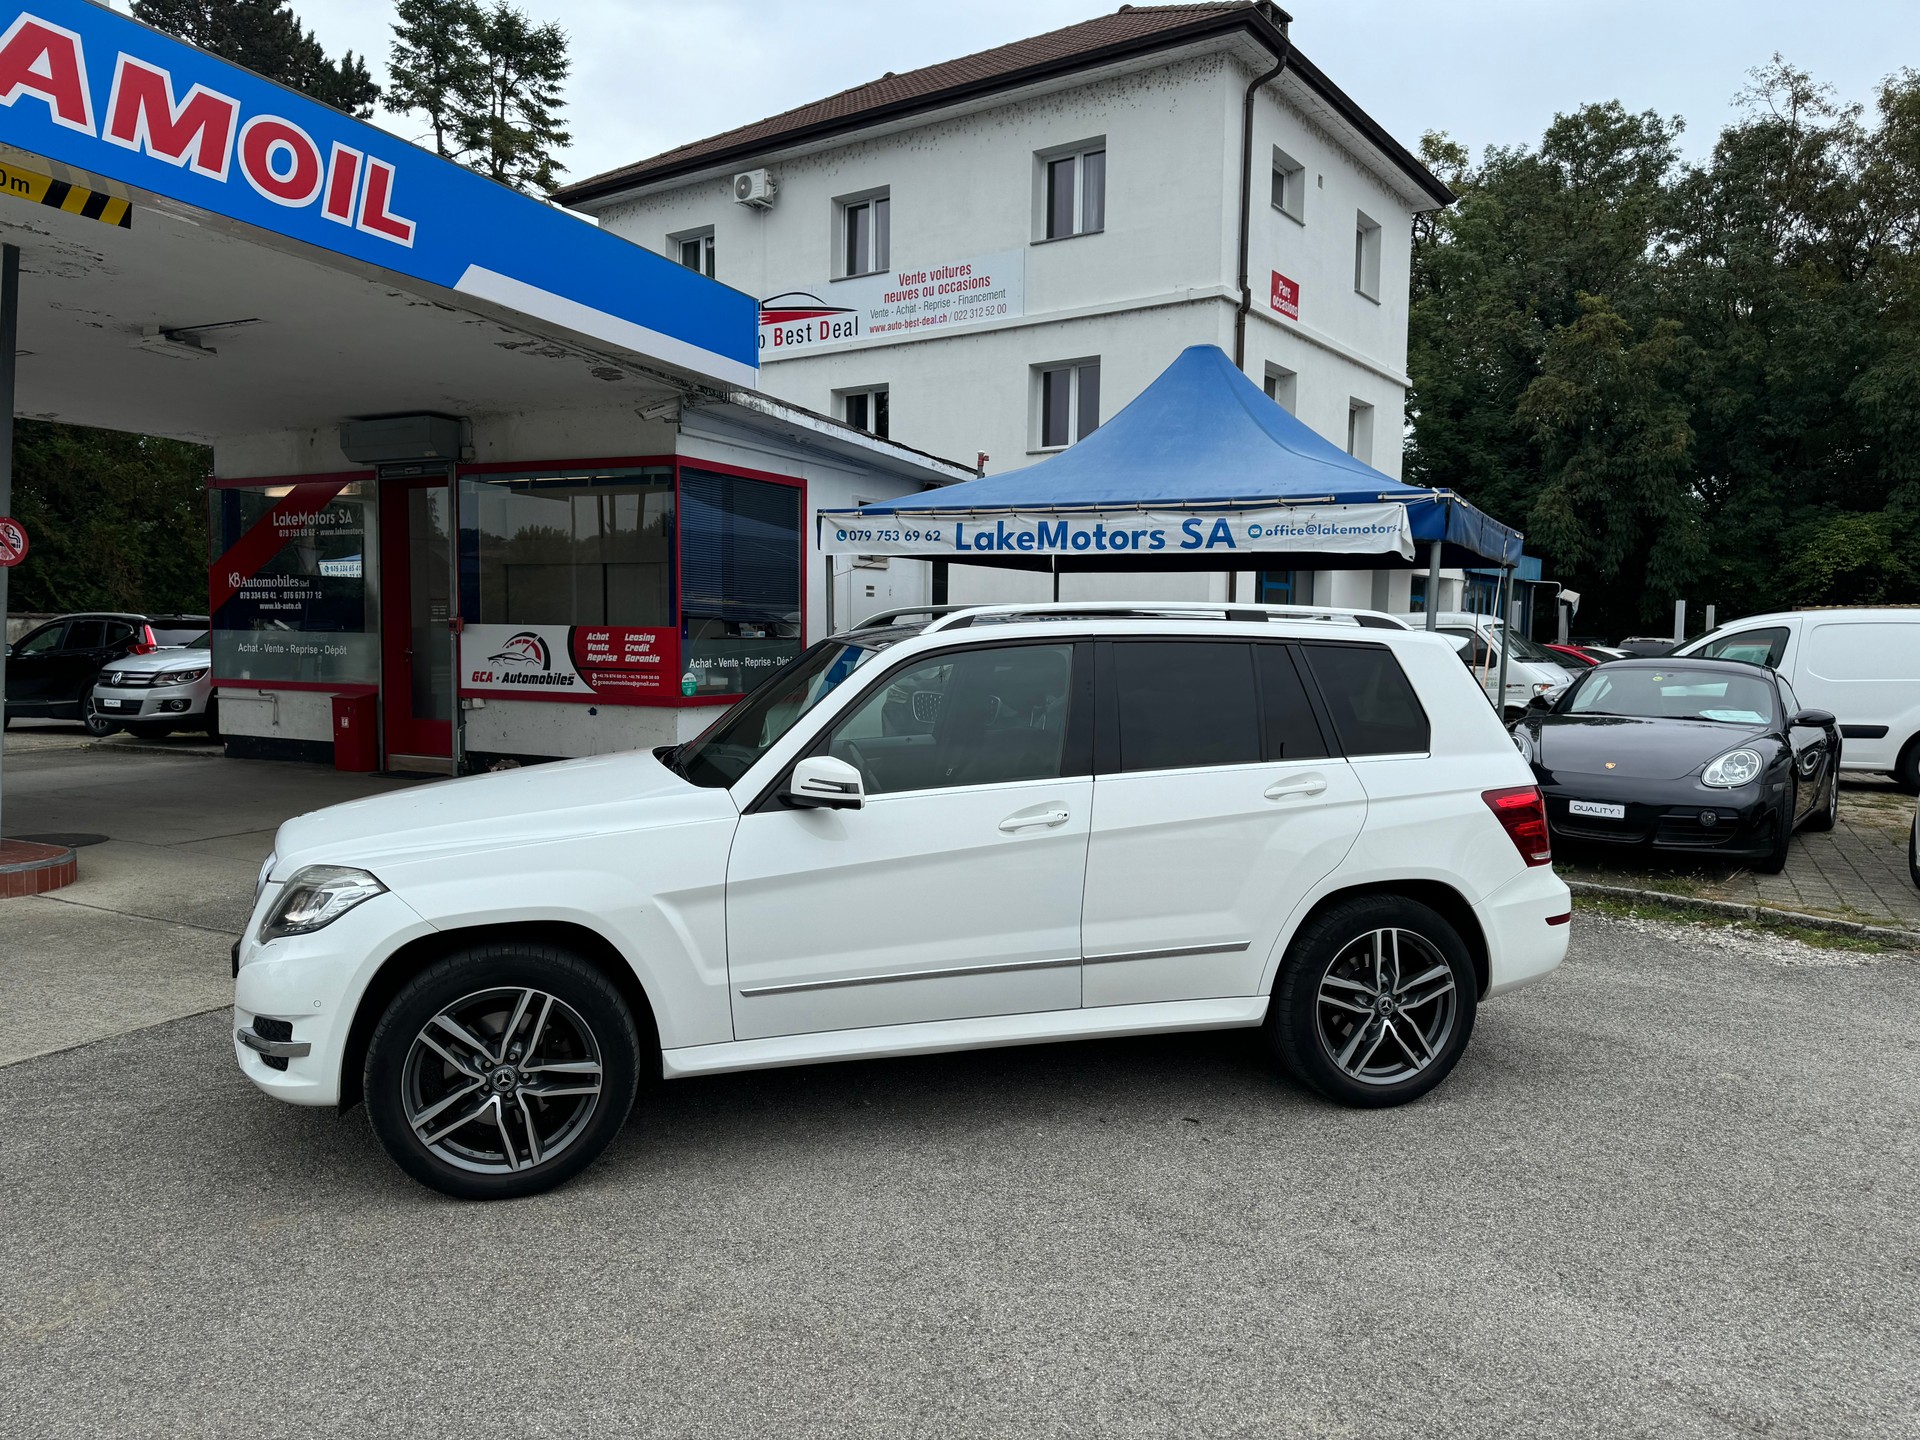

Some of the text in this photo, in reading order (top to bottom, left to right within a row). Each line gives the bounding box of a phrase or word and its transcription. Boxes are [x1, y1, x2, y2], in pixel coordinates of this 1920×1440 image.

[0, 11, 416, 248] AMOIL
[898, 264, 972, 287] Vente voitures
[884, 275, 991, 304] neuves ou occasions
[870, 309, 889, 319] Vente
[896, 303, 917, 315] Achat
[923, 298, 951, 312] Reprise
[958, 288, 1006, 306] Financement
[869, 313, 947, 333] www.auto-best-deal.ch
[954, 310, 968, 321] 022
[970, 307, 983, 319] 312
[985, 305, 995, 316] 52
[997, 303, 1007, 315] 00
[774, 327, 813, 347] Best
[820, 315, 859, 341] Deal
[273, 508, 353, 527] LakeMotors SA
[849, 530, 941, 541] 079 753 69 62
[955, 517, 1237, 551] LakeMotors SA
[240, 591, 250, 599] 079
[251, 591, 260, 599] 334
[306, 591, 313, 599] 77
[315, 591, 322, 599] 12
[587, 632, 609, 641] Achat
[624, 633, 656, 643] Leasing
[238, 643, 258, 653] Achat
[264, 643, 284, 653] Vente
[290, 644, 318, 655] Reprise
[324, 645, 347, 656] Dépôt
[587, 643, 609, 651] Vente
[625, 644, 650, 652] Credit
[587, 653, 618, 663] Reprise
[625, 654, 660, 663] Garantie
[689, 658, 712, 669] Achat
[718, 657, 739, 668] Vente
[745, 657, 771, 669] Reprise
[471, 671, 575, 686] GCA Automobiles
[1573, 804, 1615, 815] QUALITY
